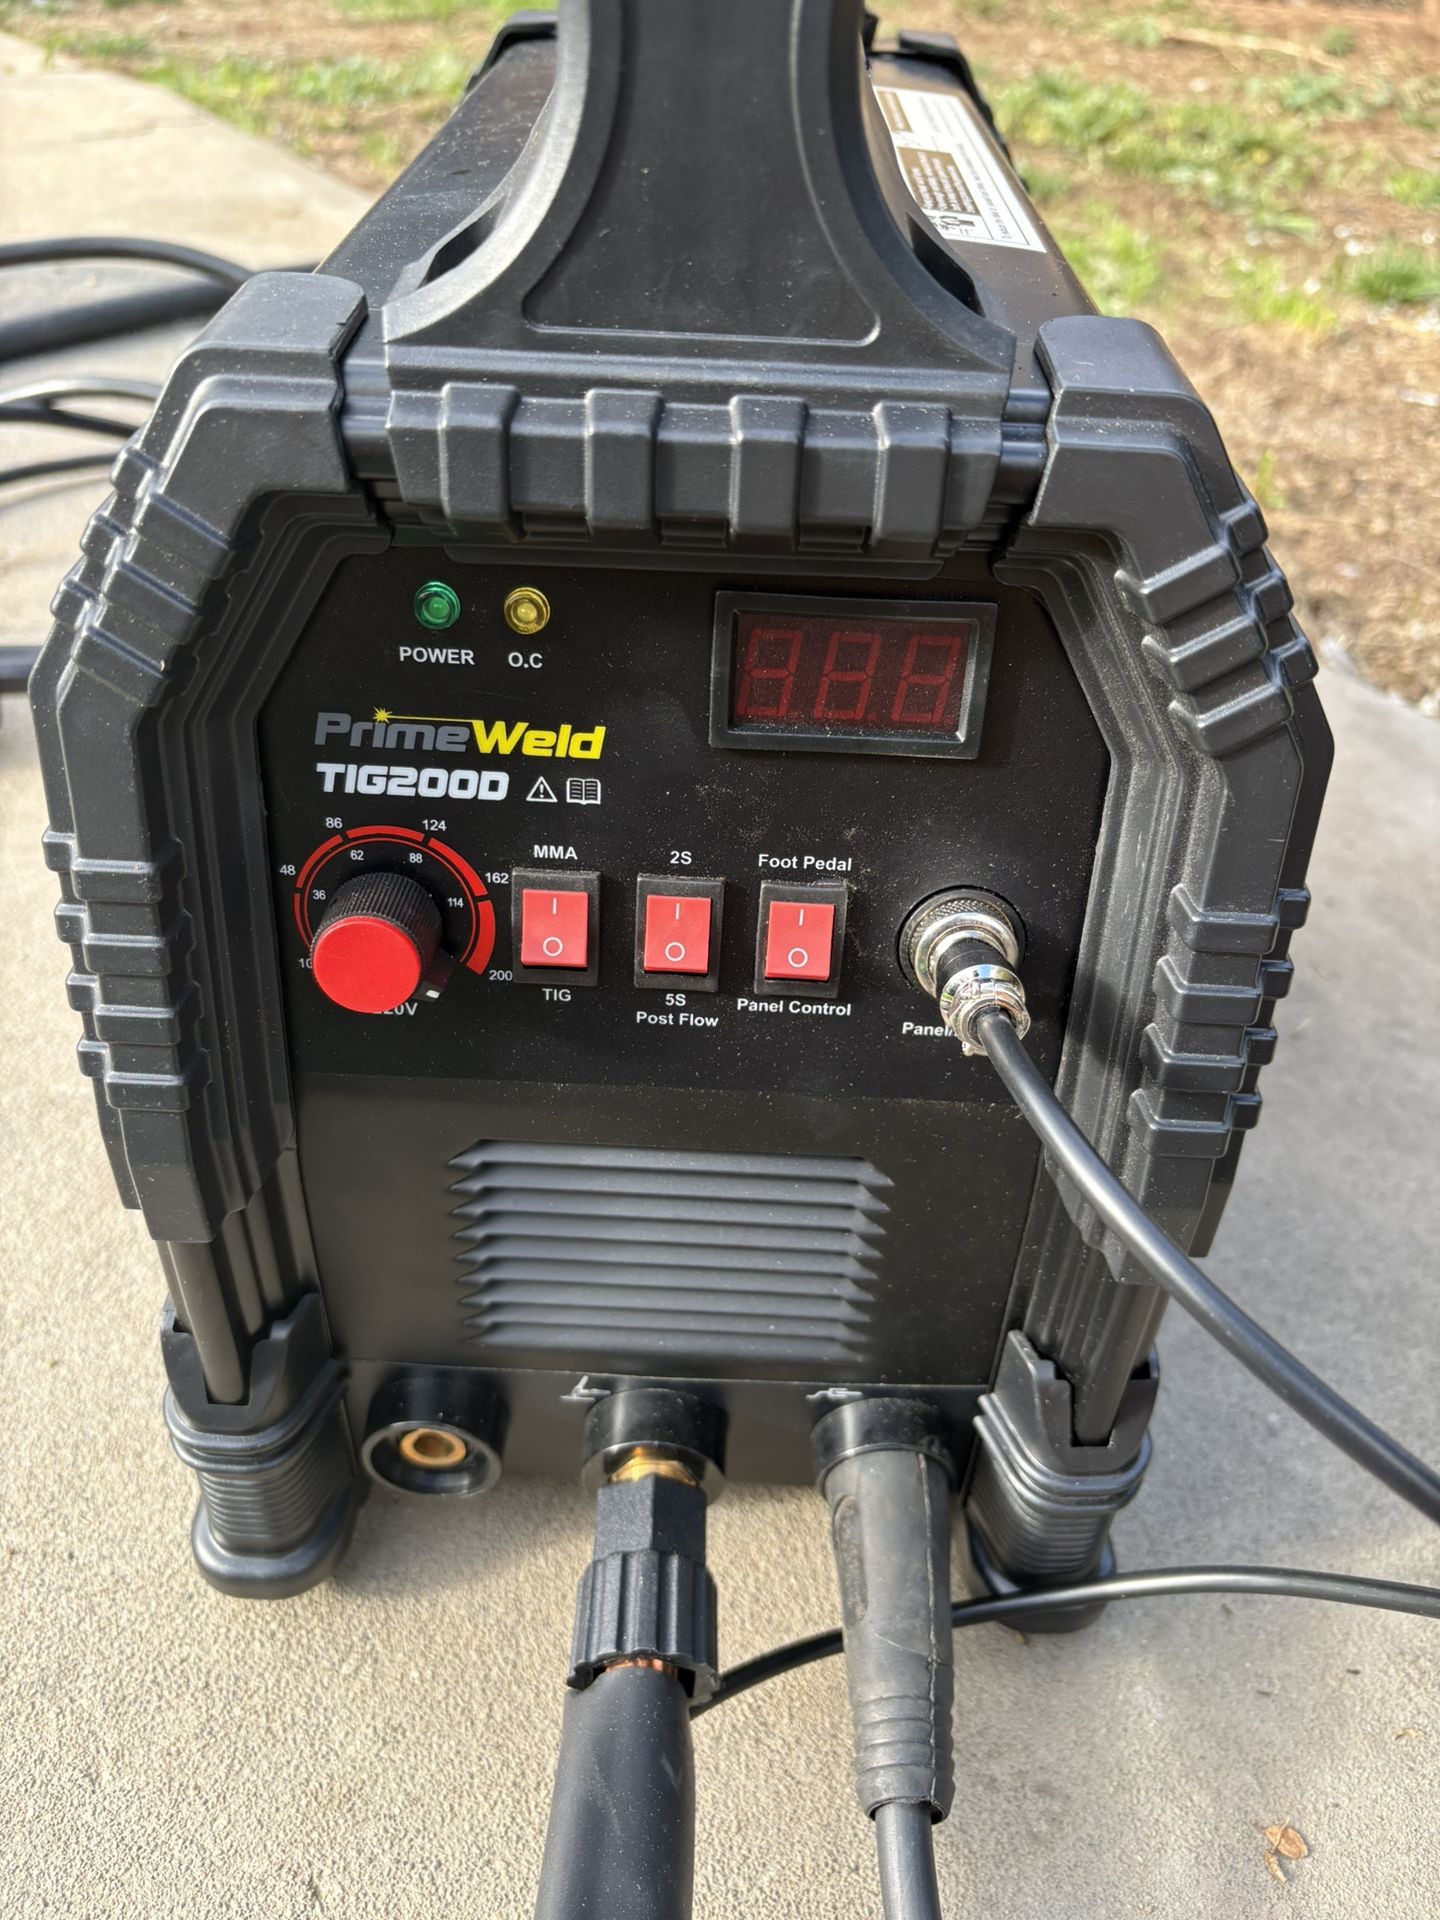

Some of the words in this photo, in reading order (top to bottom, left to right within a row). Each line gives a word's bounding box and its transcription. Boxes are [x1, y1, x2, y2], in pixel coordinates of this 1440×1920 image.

[399, 646, 475, 665] POWER
[507, 652, 543, 669] O.C
[313, 711, 607, 760] PrimeWeld
[316, 762, 510, 801] TIG200D
[325, 817, 343, 829] 86
[422, 819, 448, 831] 124
[350, 850, 364, 861] 62
[409, 853, 423, 864] 88
[533, 844, 578, 861] MMA
[670, 850, 692, 865] 2S
[758, 853, 798, 869] Foot
[804, 855, 852, 872] Pedal
[279, 864, 296, 876] 48
[485, 871, 510, 884] 162
[312, 889, 326, 901] 36
[447, 897, 464, 908] 114
[489, 969, 514, 981] 200
[542, 988, 572, 1002] TIG
[665, 993, 687, 1007] 5S
[737, 997, 783, 1013] Panel
[788, 1000, 852, 1016] Control
[636, 1010, 674, 1025] Post
[681, 1012, 719, 1027] Flow
